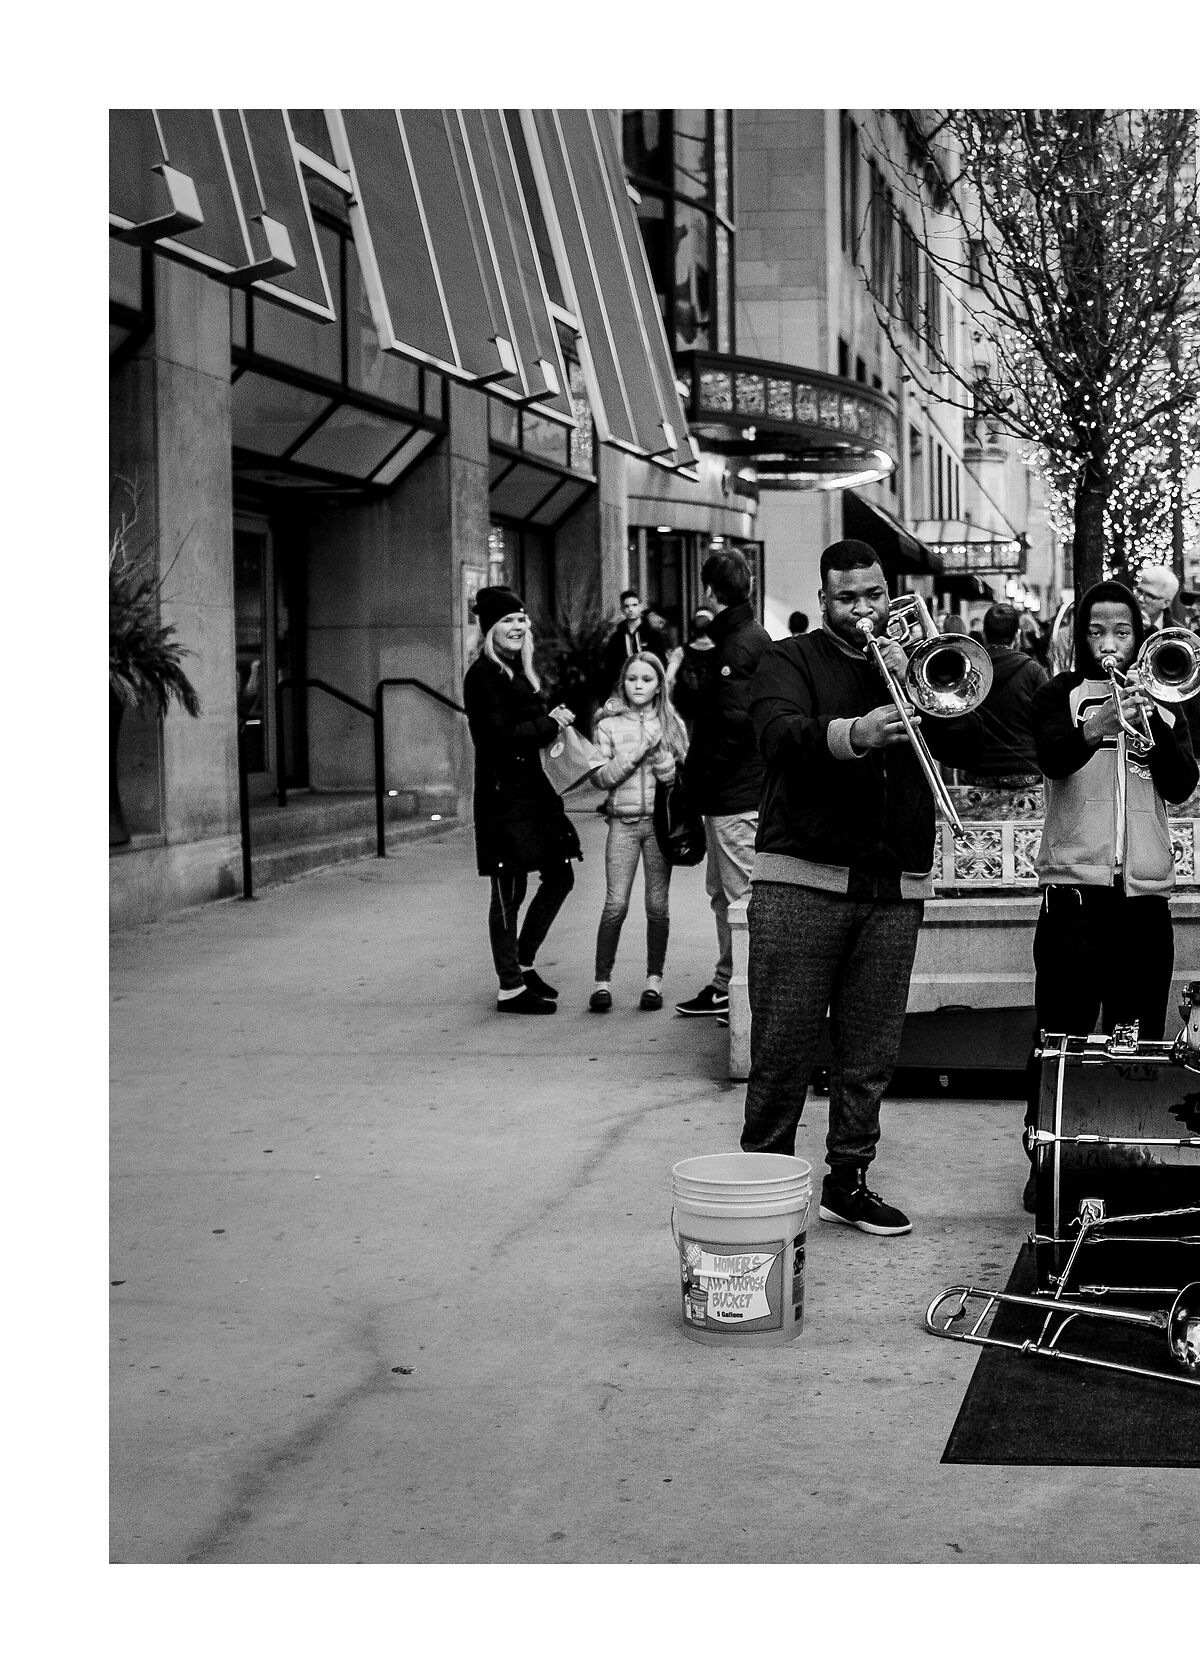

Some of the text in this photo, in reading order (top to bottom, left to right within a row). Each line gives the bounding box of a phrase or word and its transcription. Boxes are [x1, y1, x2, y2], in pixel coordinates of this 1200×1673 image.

[714, 1256, 762, 1274] HOMER'S
[712, 1292, 753, 1309] BUCKET
[721, 1310, 744, 1318] Gallons
